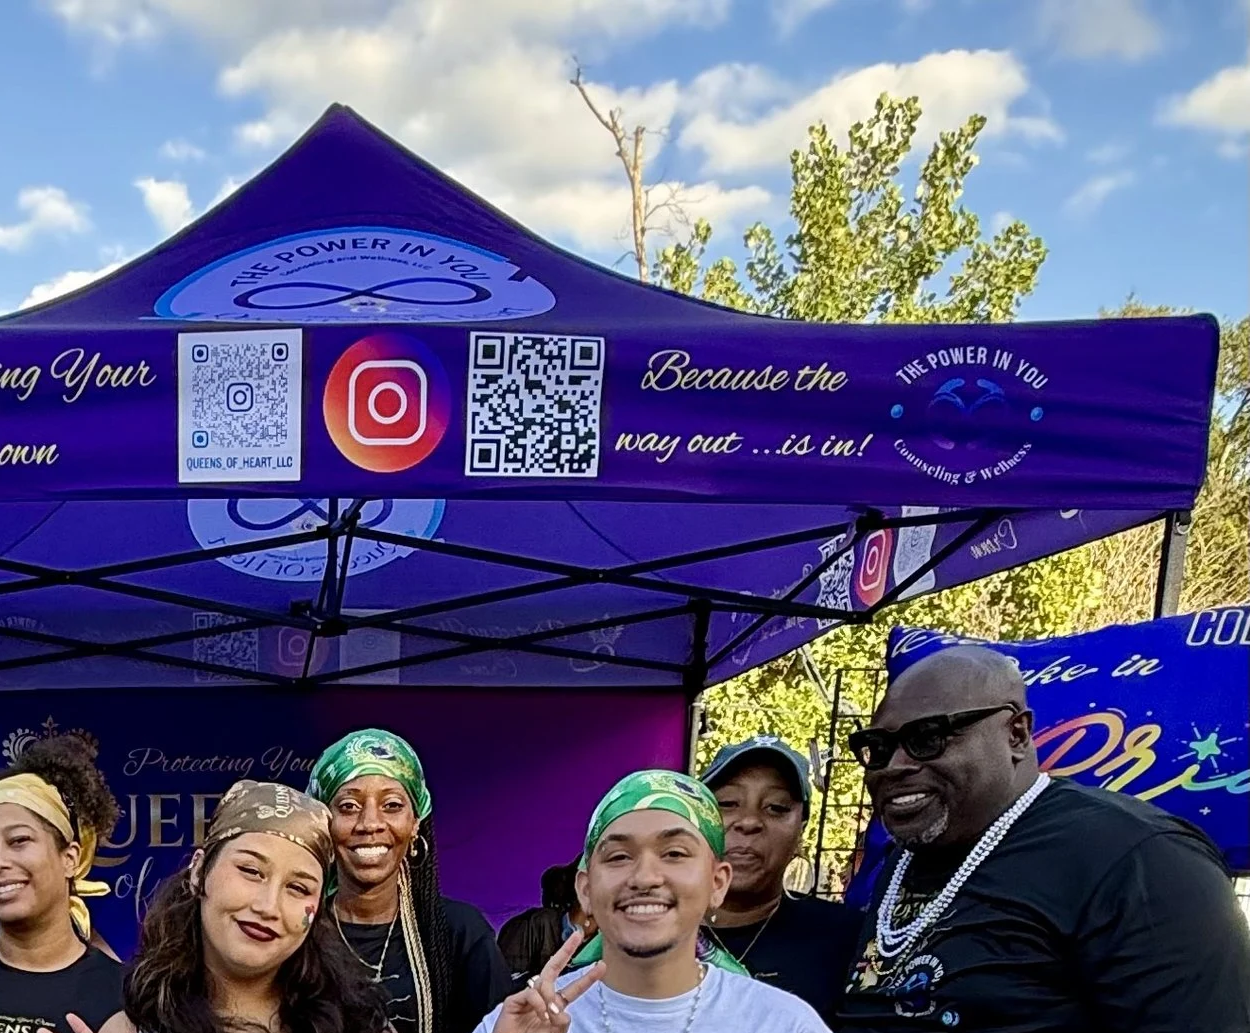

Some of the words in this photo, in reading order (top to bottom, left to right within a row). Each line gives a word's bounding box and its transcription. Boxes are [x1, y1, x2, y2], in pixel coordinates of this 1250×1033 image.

[230, 262, 280, 288] THE
[274, 238, 391, 264] POWER
[399, 242, 436, 258] IN
[439, 255, 492, 281] YOU
[50, 348, 157, 403] Your
[641, 349, 790, 391] Because
[794, 362, 849, 392] the
[896, 359, 929, 385] THE
[926, 346, 988, 370] POWER
[992, 349, 1013, 371] IN
[1015, 359, 1049, 389] YOU
[186, 456, 293, 471] QUEENS_OF_HEART_LLC
[615, 432, 681, 463] way
[687, 432, 744, 454] out
[820, 433, 874, 457] in!
[893, 439, 961, 485] Counseling
[964, 470, 978, 484] &
[980, 441, 1033, 480] Wellness
[1111, 654, 1164, 679] in
[123, 748, 254, 778] Protecting
